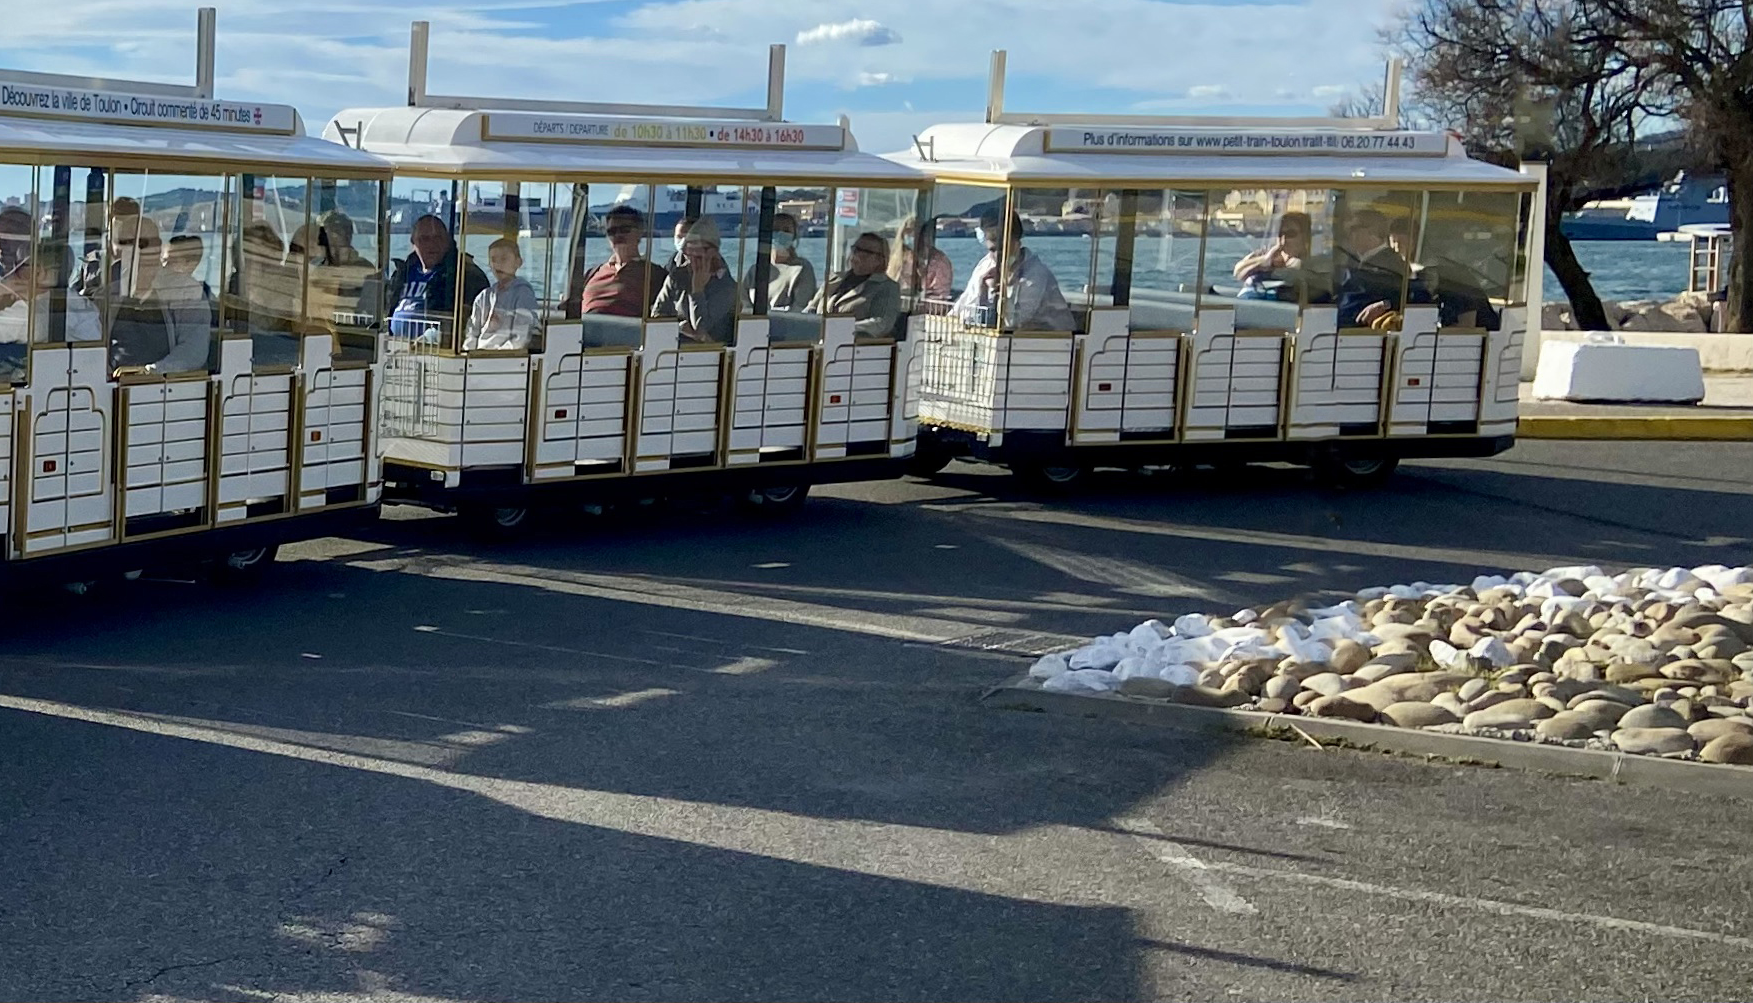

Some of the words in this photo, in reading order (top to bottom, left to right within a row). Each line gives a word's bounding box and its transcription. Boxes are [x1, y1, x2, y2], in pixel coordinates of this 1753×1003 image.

[2, 85, 50, 109] Découvrez
[52, 89, 60, 109] la
[62, 91, 78, 110] ville
[80, 93, 92, 112] de
[93, 94, 122, 114] Toulon
[130, 97, 156, 116] Circuit
[157, 101, 197, 120] commenté
[199, 102, 209, 121] de
[211, 103, 221, 121] 45
[222, 106, 251, 123] minutes
[533, 120, 564, 134] DÉPARTS
[569, 123, 609, 136] DEPARTURE
[614, 124, 627, 138] de
[632, 124, 663, 139] 10h30
[665, 125, 672, 140] à
[676, 126, 706, 140] 11h30
[717, 127, 730, 141] de
[734, 128, 763, 142] 14h30
[766, 128, 772, 142] à
[775, 129, 804, 143] 16h30
[1083, 132, 1105, 146] Plus
[1107, 132, 1175, 147] d'informations
[1178, 135, 1193, 147] sur
[1341, 135, 1415, 149] 06.20.77.44.43
